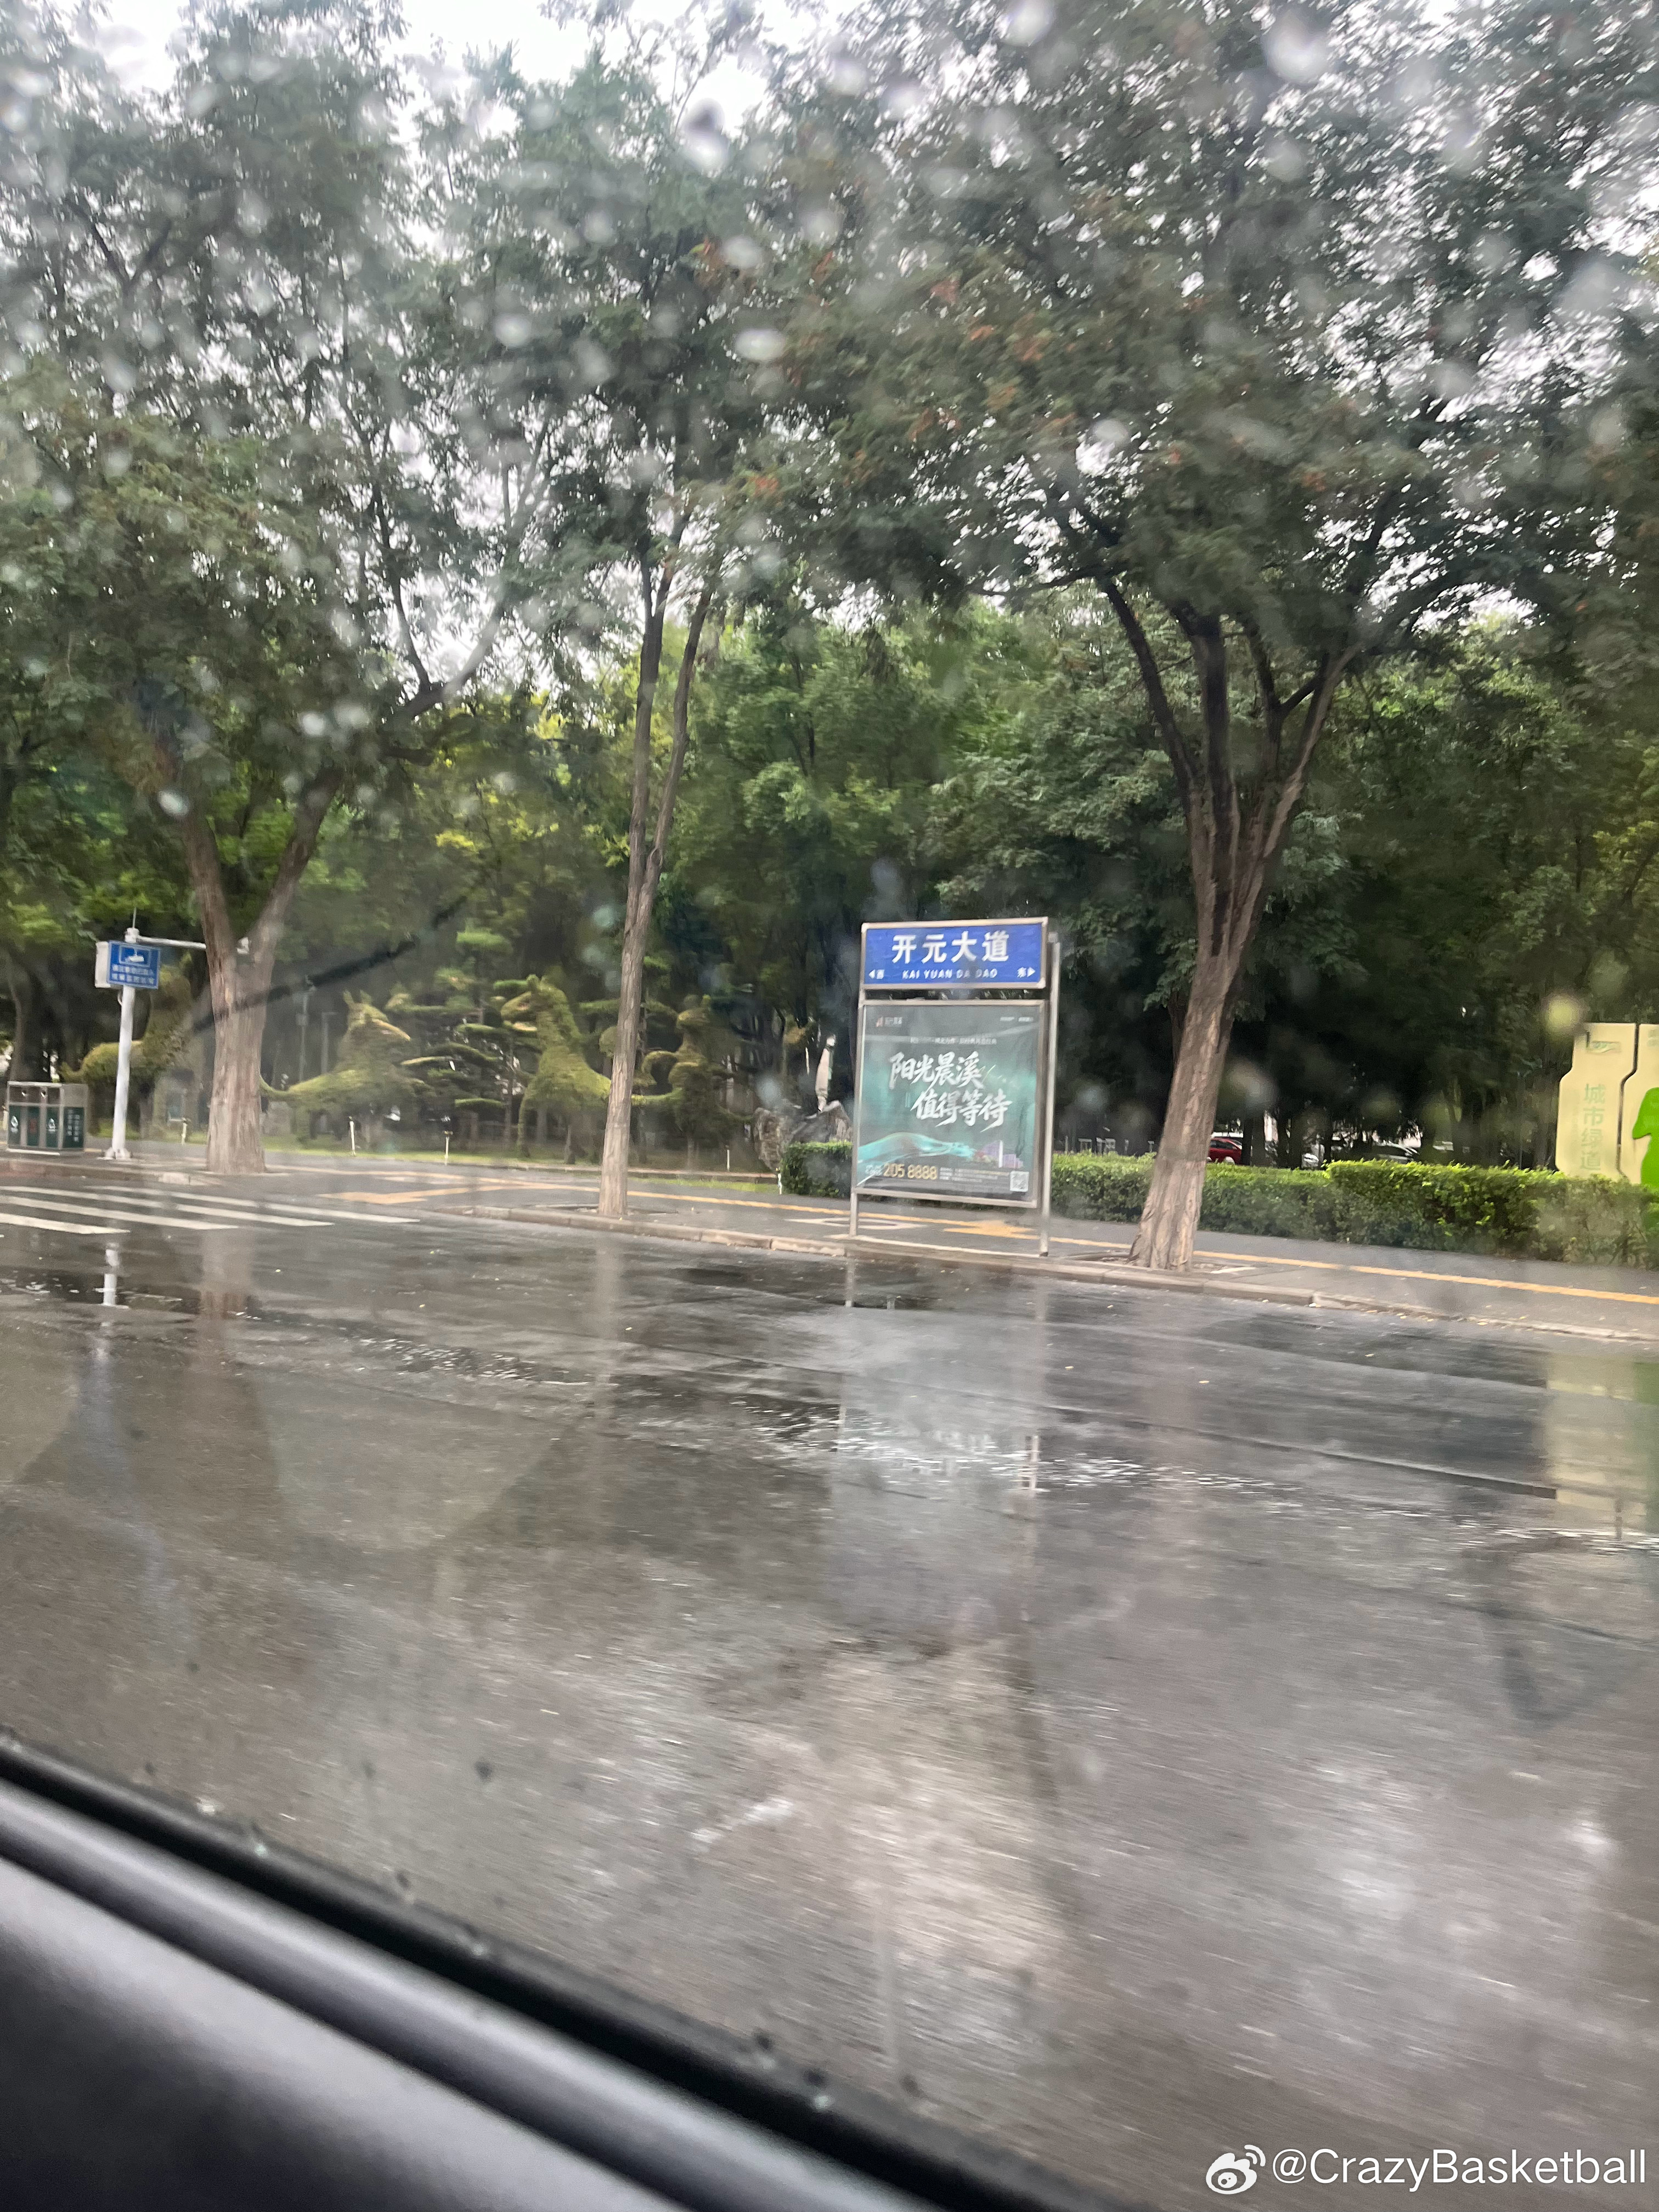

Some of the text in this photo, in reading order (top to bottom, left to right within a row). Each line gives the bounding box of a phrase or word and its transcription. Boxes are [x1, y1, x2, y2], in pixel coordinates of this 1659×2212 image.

[891, 930, 1009, 964] 开元大道
[902, 968, 998, 979] KAI YUAN DA DAO
[888, 1051, 985, 1091] 阳光晨溪
[910, 1088, 1013, 1133] 值得等待
[1579, 1083, 1607, 1172] 城市绿道
[883, 1163, 905, 1178] 205
[907, 1164, 938, 1180] 8888
